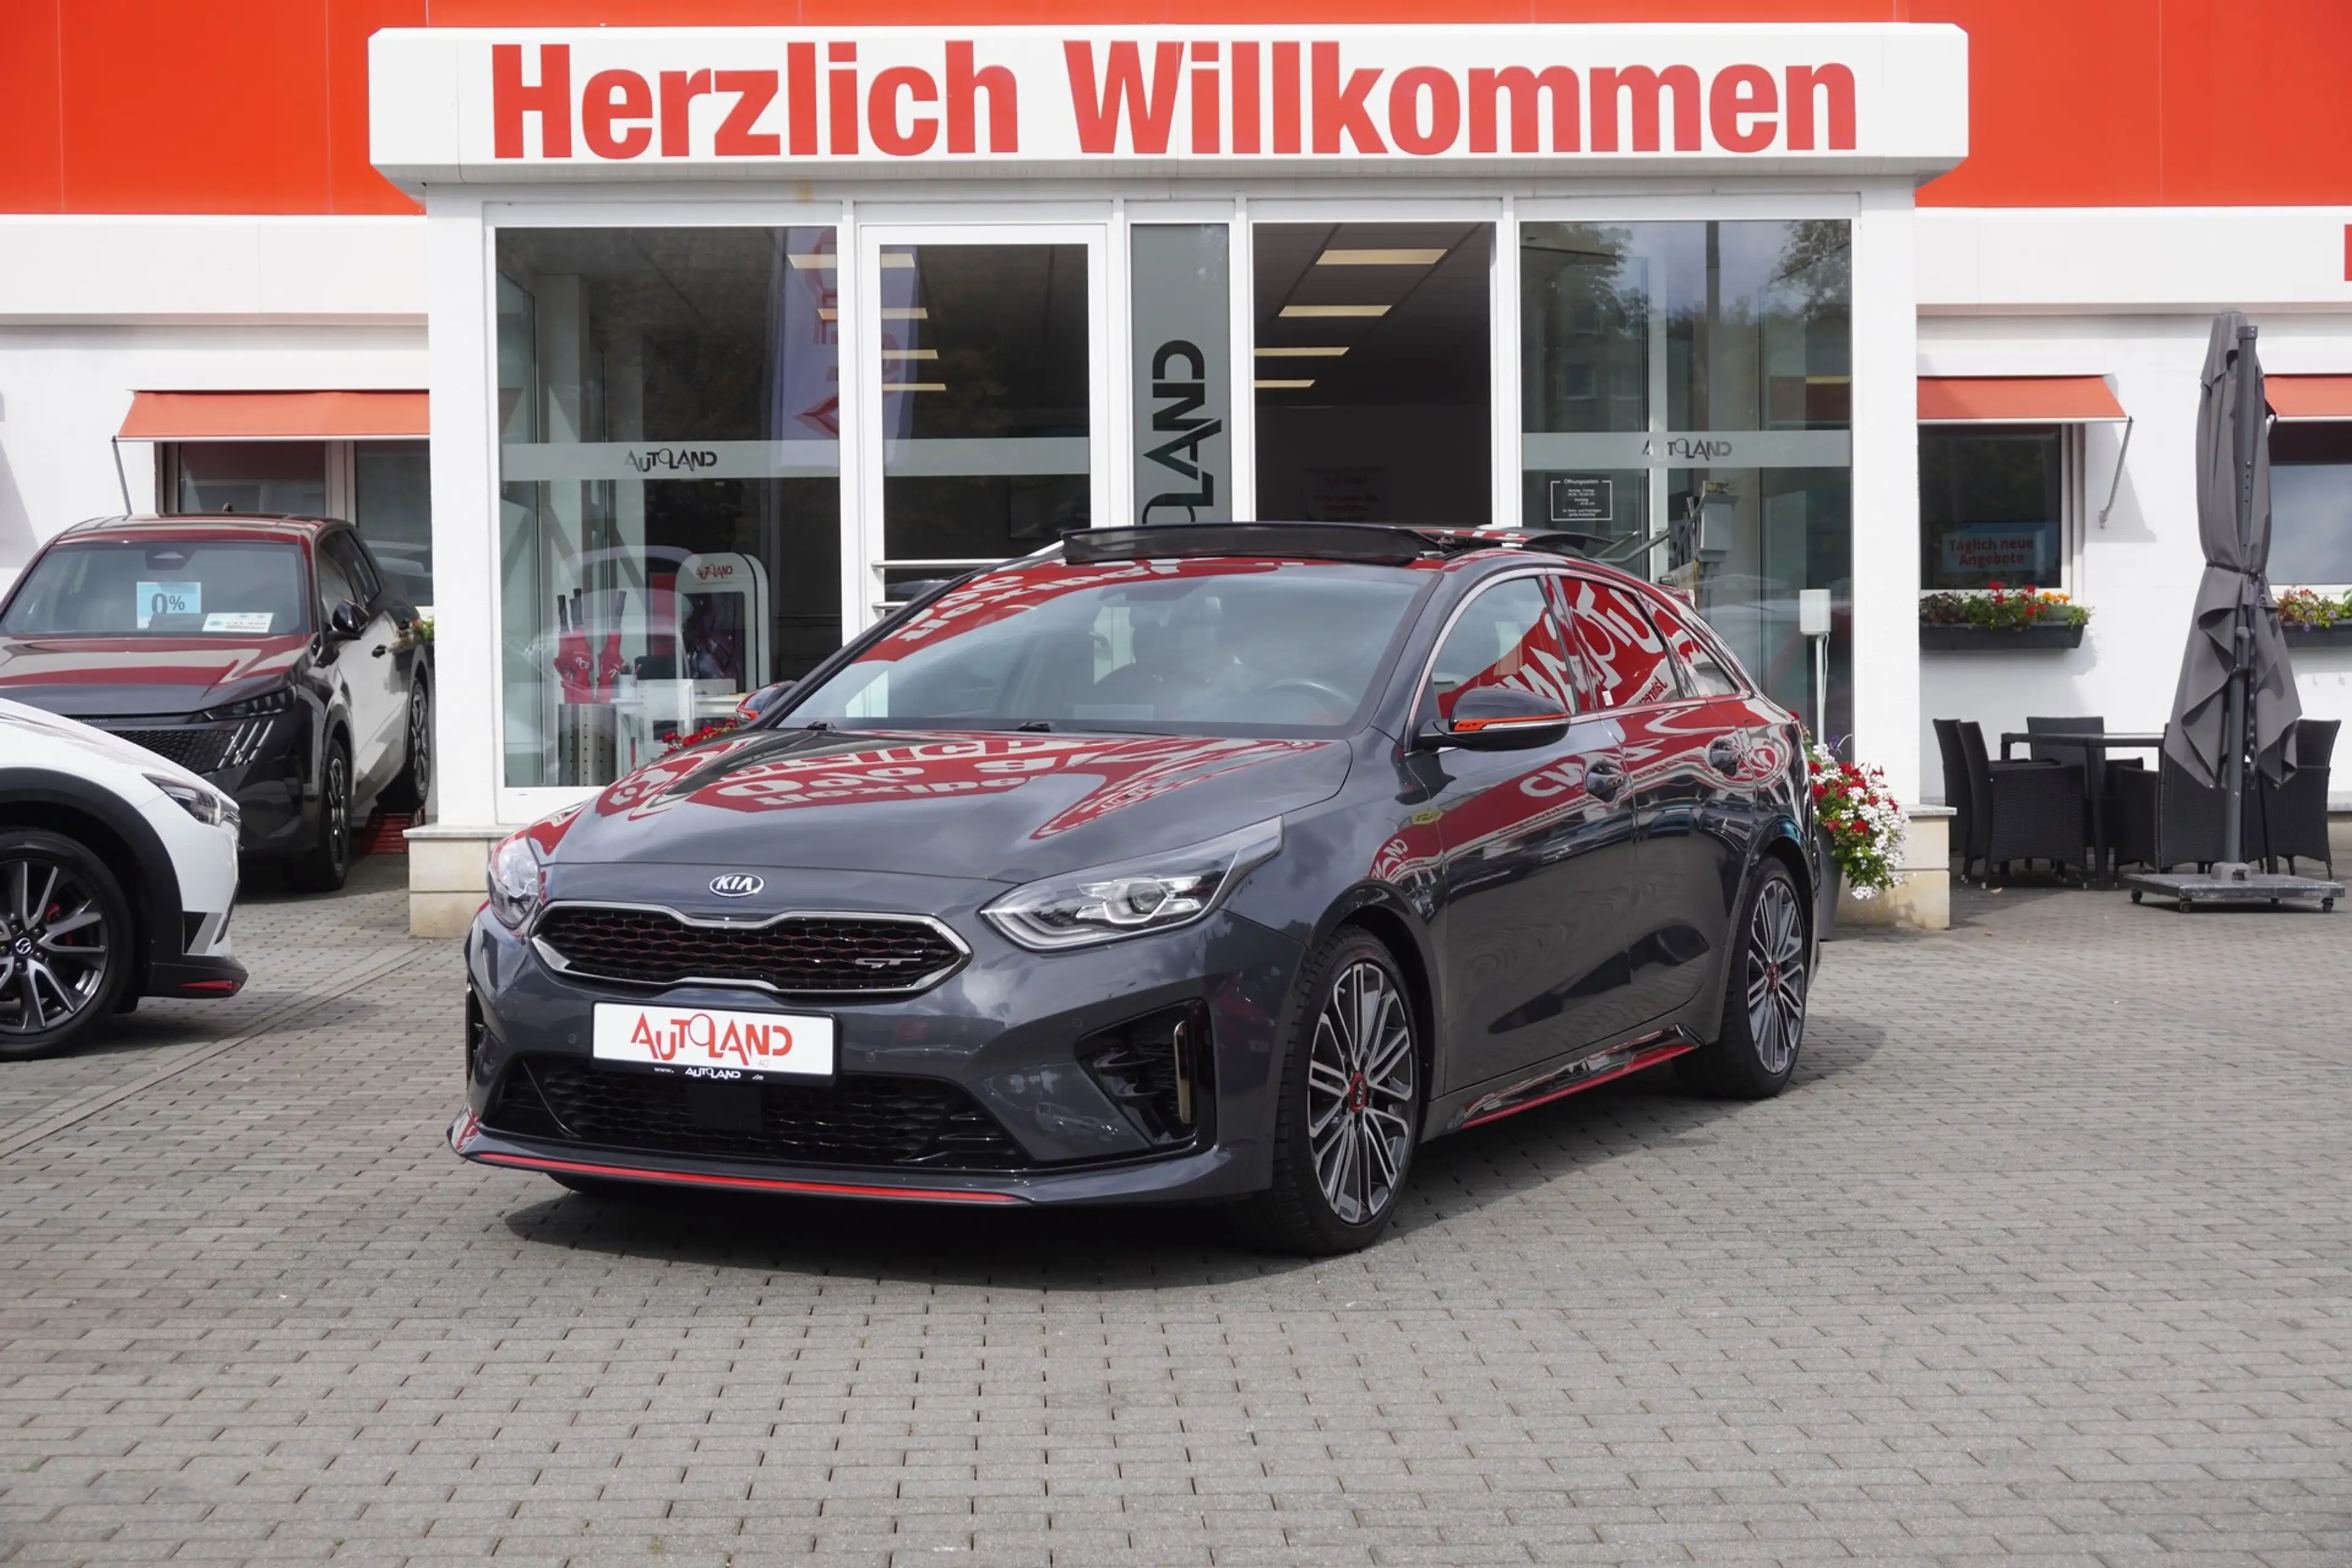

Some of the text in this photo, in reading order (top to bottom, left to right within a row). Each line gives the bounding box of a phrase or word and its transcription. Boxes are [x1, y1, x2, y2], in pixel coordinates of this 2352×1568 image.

[492, 40, 1856, 159] Herzlich Willkommen
[624, 448, 718, 472] AUTOLAND
[2000, 538, 2034, 549] neue
[1959, 552, 2025, 568] Angebote
[696, 564, 733, 579] AUTOLAND
[151, 592, 186, 613] 0%
[715, 876, 753, 891] KIA
[855, 958, 921, 969] GT
[631, 1012, 793, 1066] AUTOLAND
[684, 1067, 742, 1080] AUTOLAND
